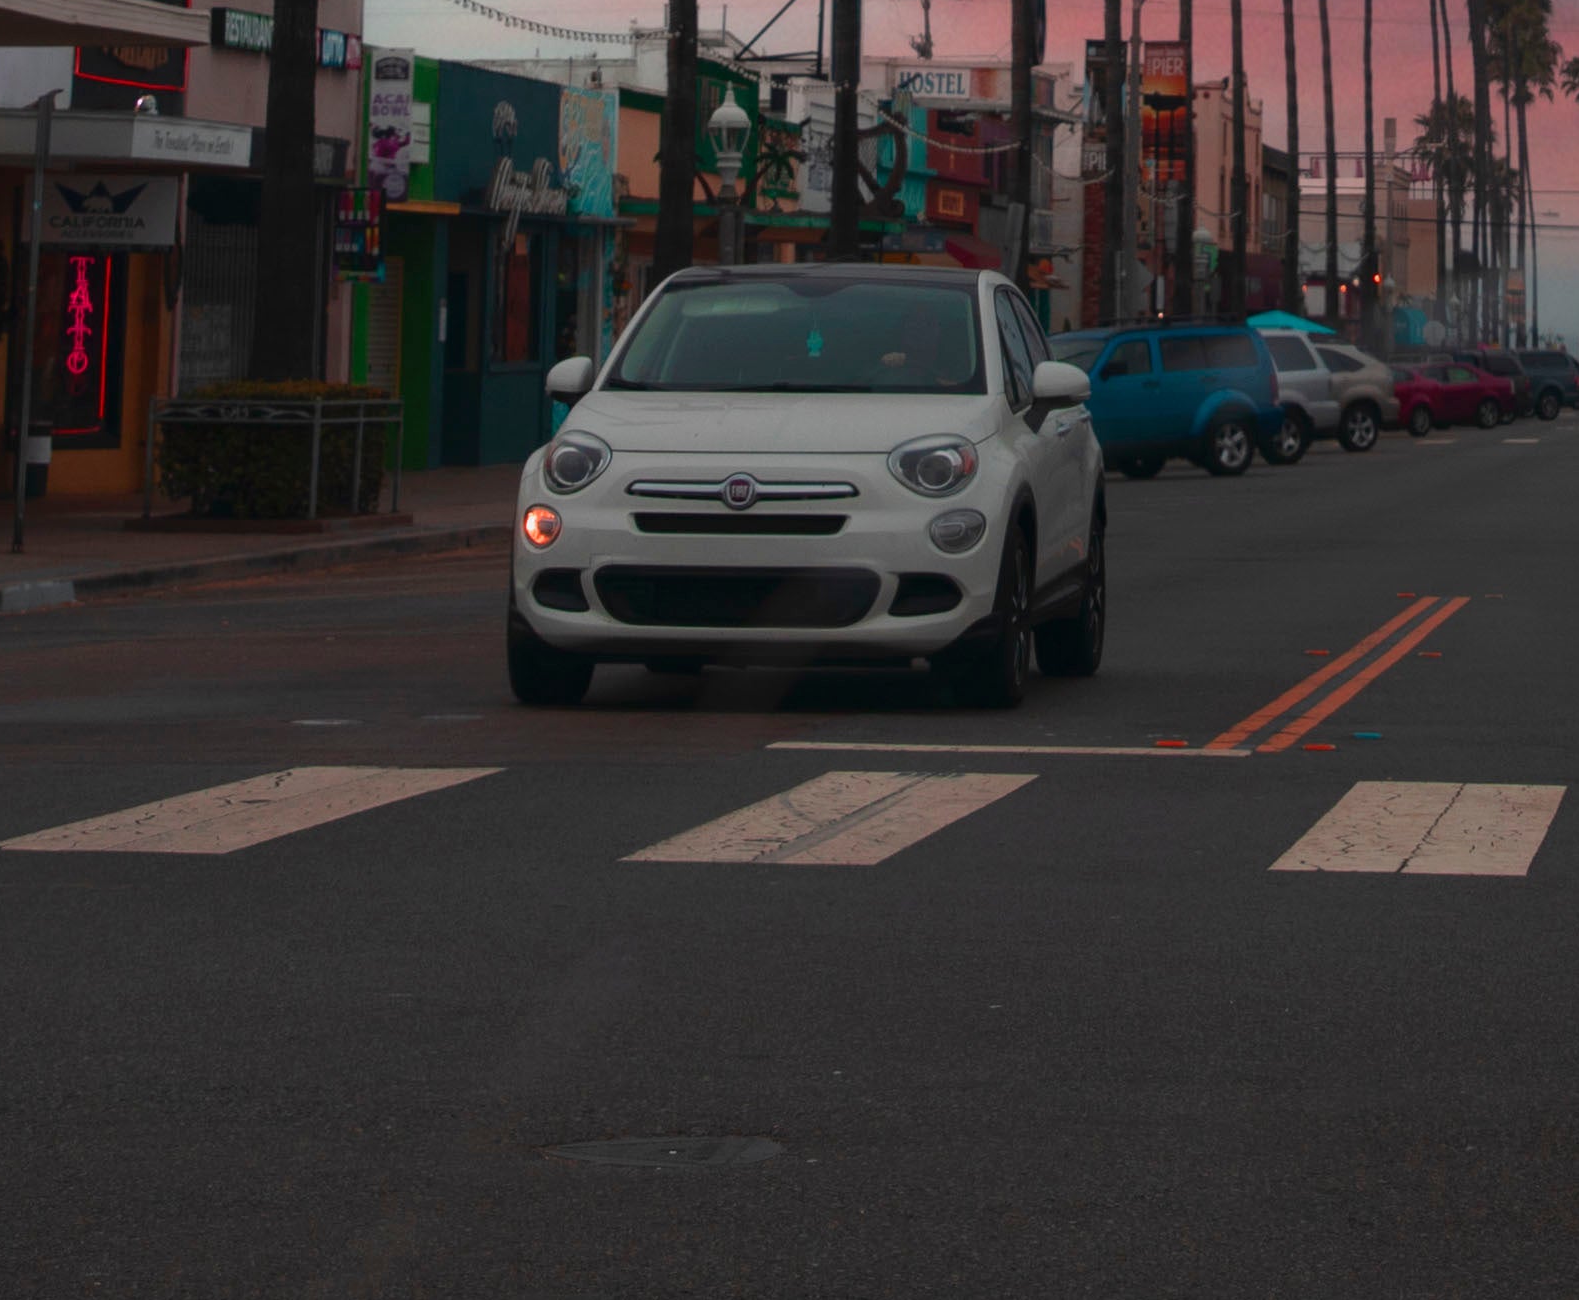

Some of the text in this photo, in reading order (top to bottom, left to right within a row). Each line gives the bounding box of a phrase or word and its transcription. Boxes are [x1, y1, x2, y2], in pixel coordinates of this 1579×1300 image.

[225, 12, 274, 51] RESTAURAN
[1151, 55, 1185, 78] PIER
[898, 70, 966, 97] HOSTEL
